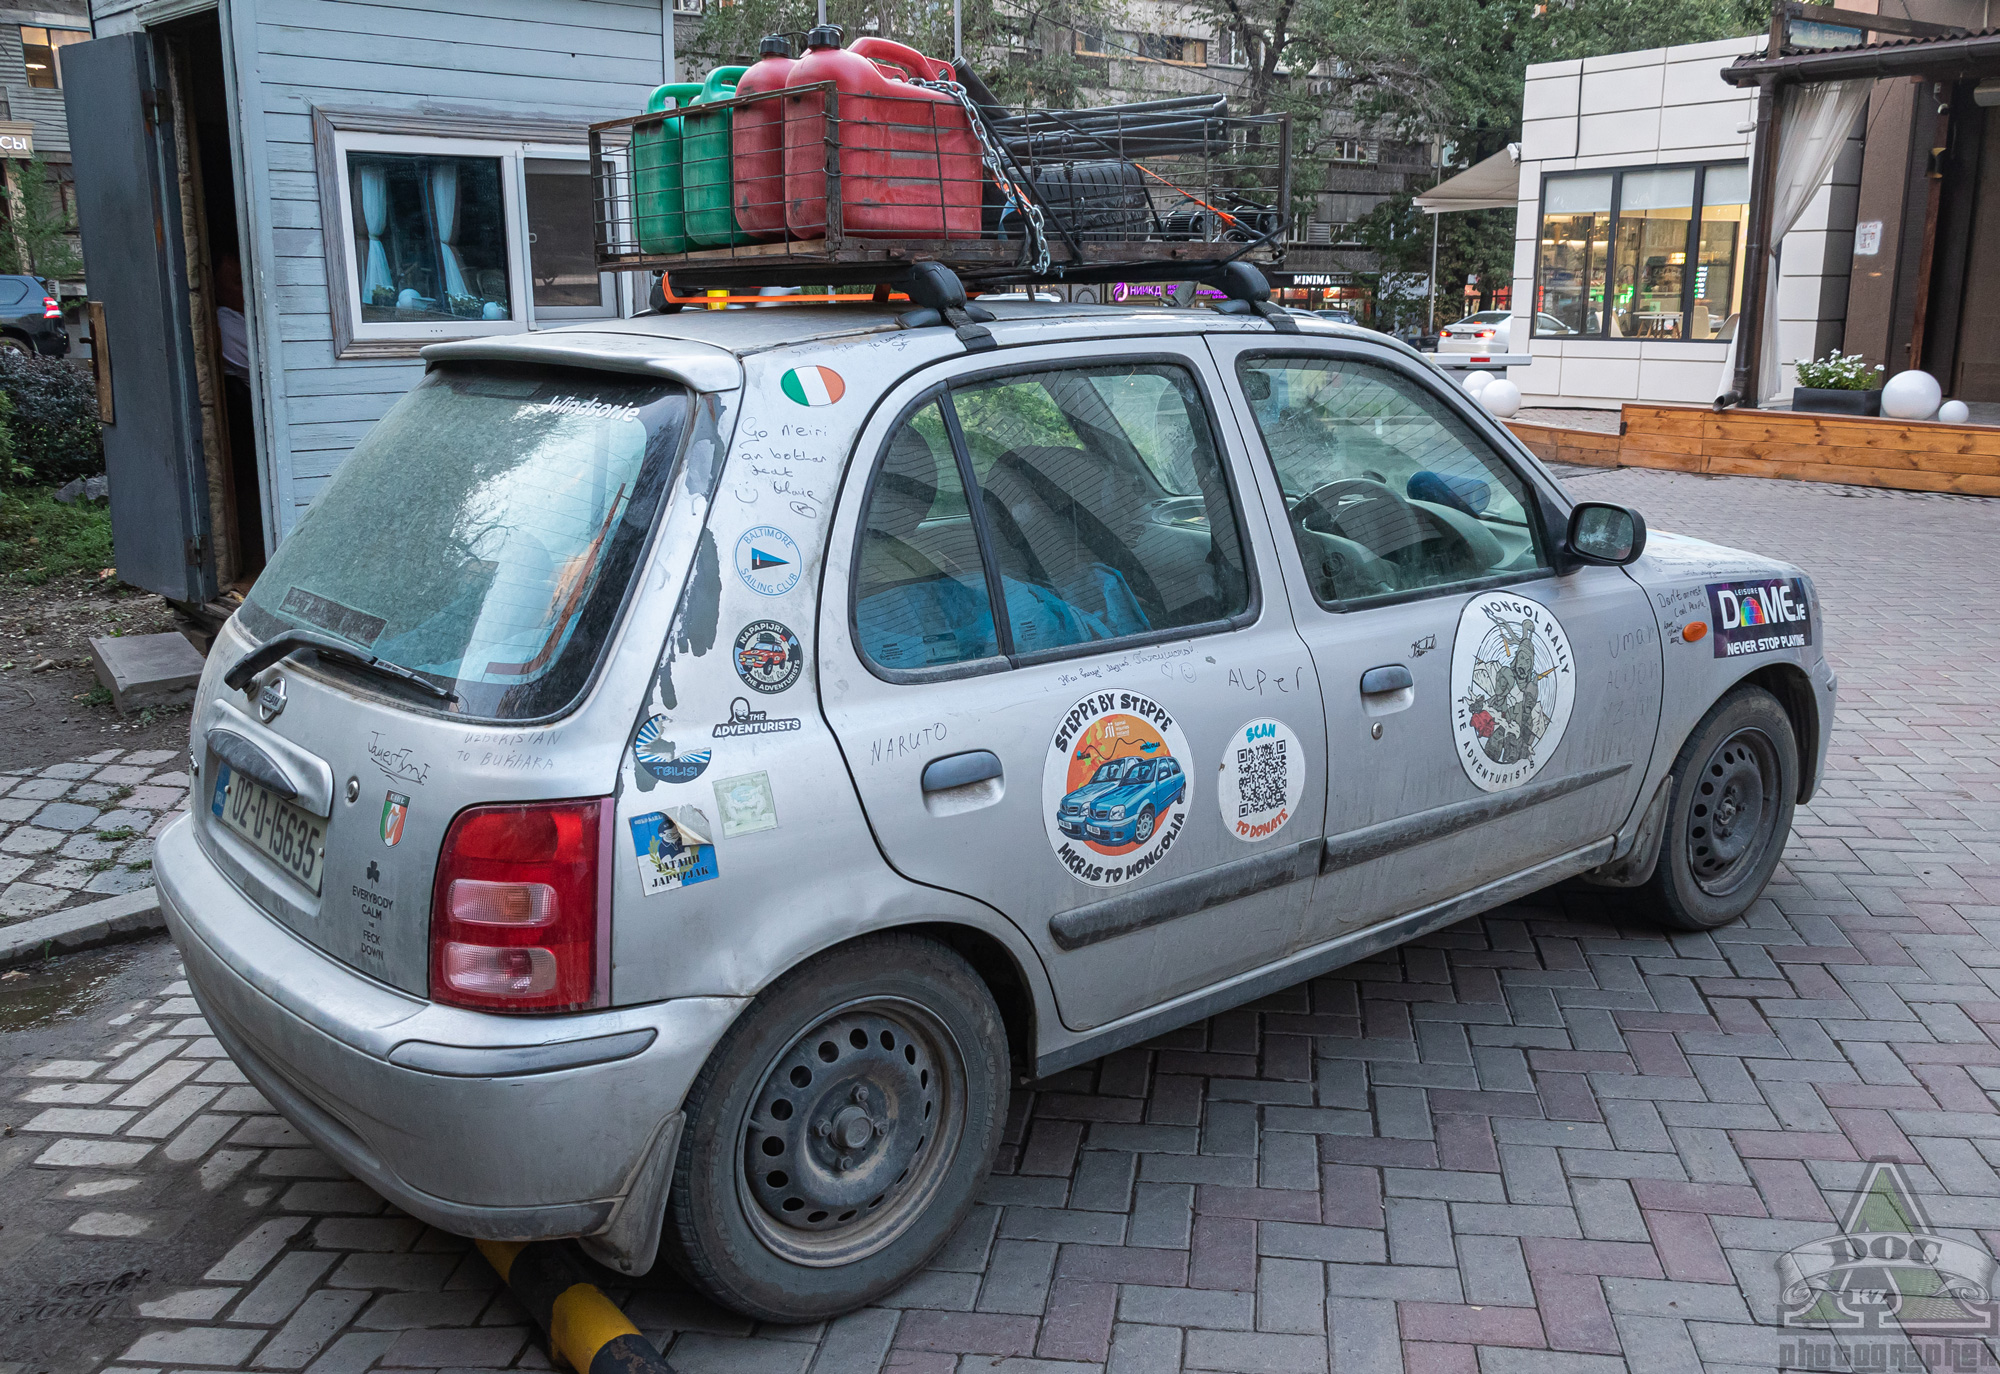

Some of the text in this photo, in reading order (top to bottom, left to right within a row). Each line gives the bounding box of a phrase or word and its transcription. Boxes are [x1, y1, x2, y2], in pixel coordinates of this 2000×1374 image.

[1129, 285, 1162, 297] НИИКД
[546, 395, 641, 423] Windsor.ie
[743, 528, 794, 549] BALTIMORE
[741, 567, 798, 594] SAILING CLUB
[1734, 587, 1759, 596] LEISURE
[739, 622, 784, 644] NAPAPIJRI
[1480, 601, 1570, 675] MONGOL RALLY
[1727, 633, 1805, 656] NEVER STOP PLAYING
[744, 659, 801, 691] THE ADVENTURISTS
[749, 712, 765, 722] THE
[1055, 693, 1173, 753] STEPPE BY STEPPE
[714, 720, 800, 737] ADVENTURISTS
[1246, 723, 1276, 743] SCAN
[870, 722, 948, 766] NARUTO
[1457, 698, 1535, 784] THE ADVENTURISTS
[457, 750, 470, 762] TO
[653, 765, 698, 777] TBILISI
[232, 776, 320, 880] 02-D-15635
[1236, 808, 1288, 838] TO DONATE
[1058, 812, 1185, 884] MICRAS TO MONGOLIA
[352, 886, 393, 910] EVERYBODY
[361, 904, 382, 920] CALM
[363, 930, 380, 946] FECK
[361, 943, 384, 960] DOWN
